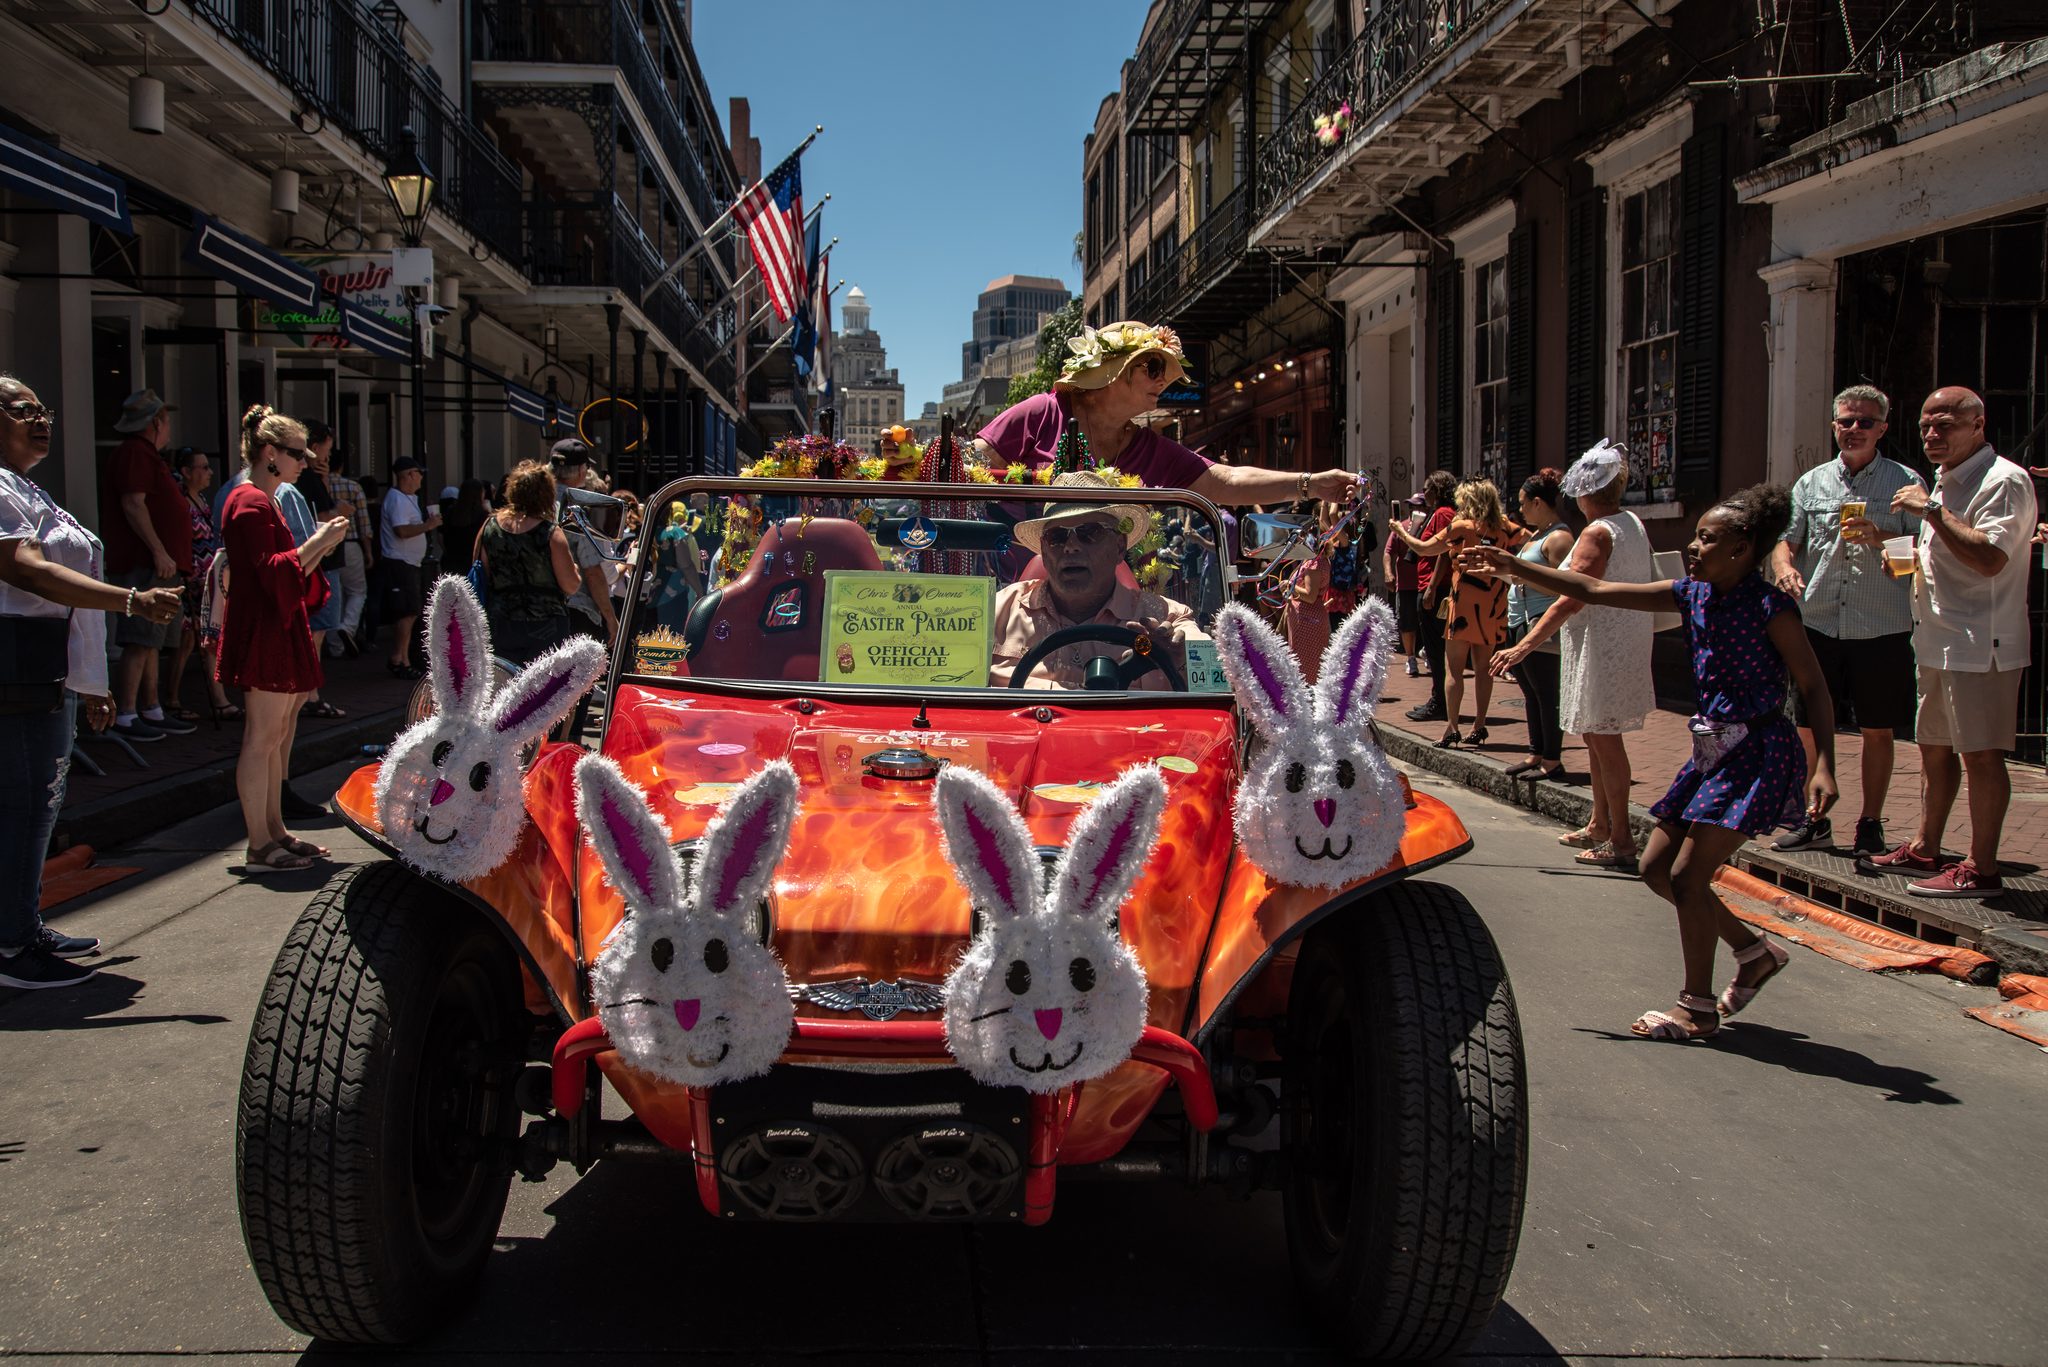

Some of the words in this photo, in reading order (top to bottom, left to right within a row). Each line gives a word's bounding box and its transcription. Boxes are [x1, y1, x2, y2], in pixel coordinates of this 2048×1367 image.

[856, 587, 888, 600] Chris
[925, 588, 963, 600] Owens
[843, 612, 904, 635] EASTER
[911, 611, 976, 637] PARADE
[867, 645, 950, 656] OFFICIAL
[868, 656, 948, 667] VEHICLE
[1191, 671, 1206, 684] 04
[856, 734, 970, 747] EASTER
